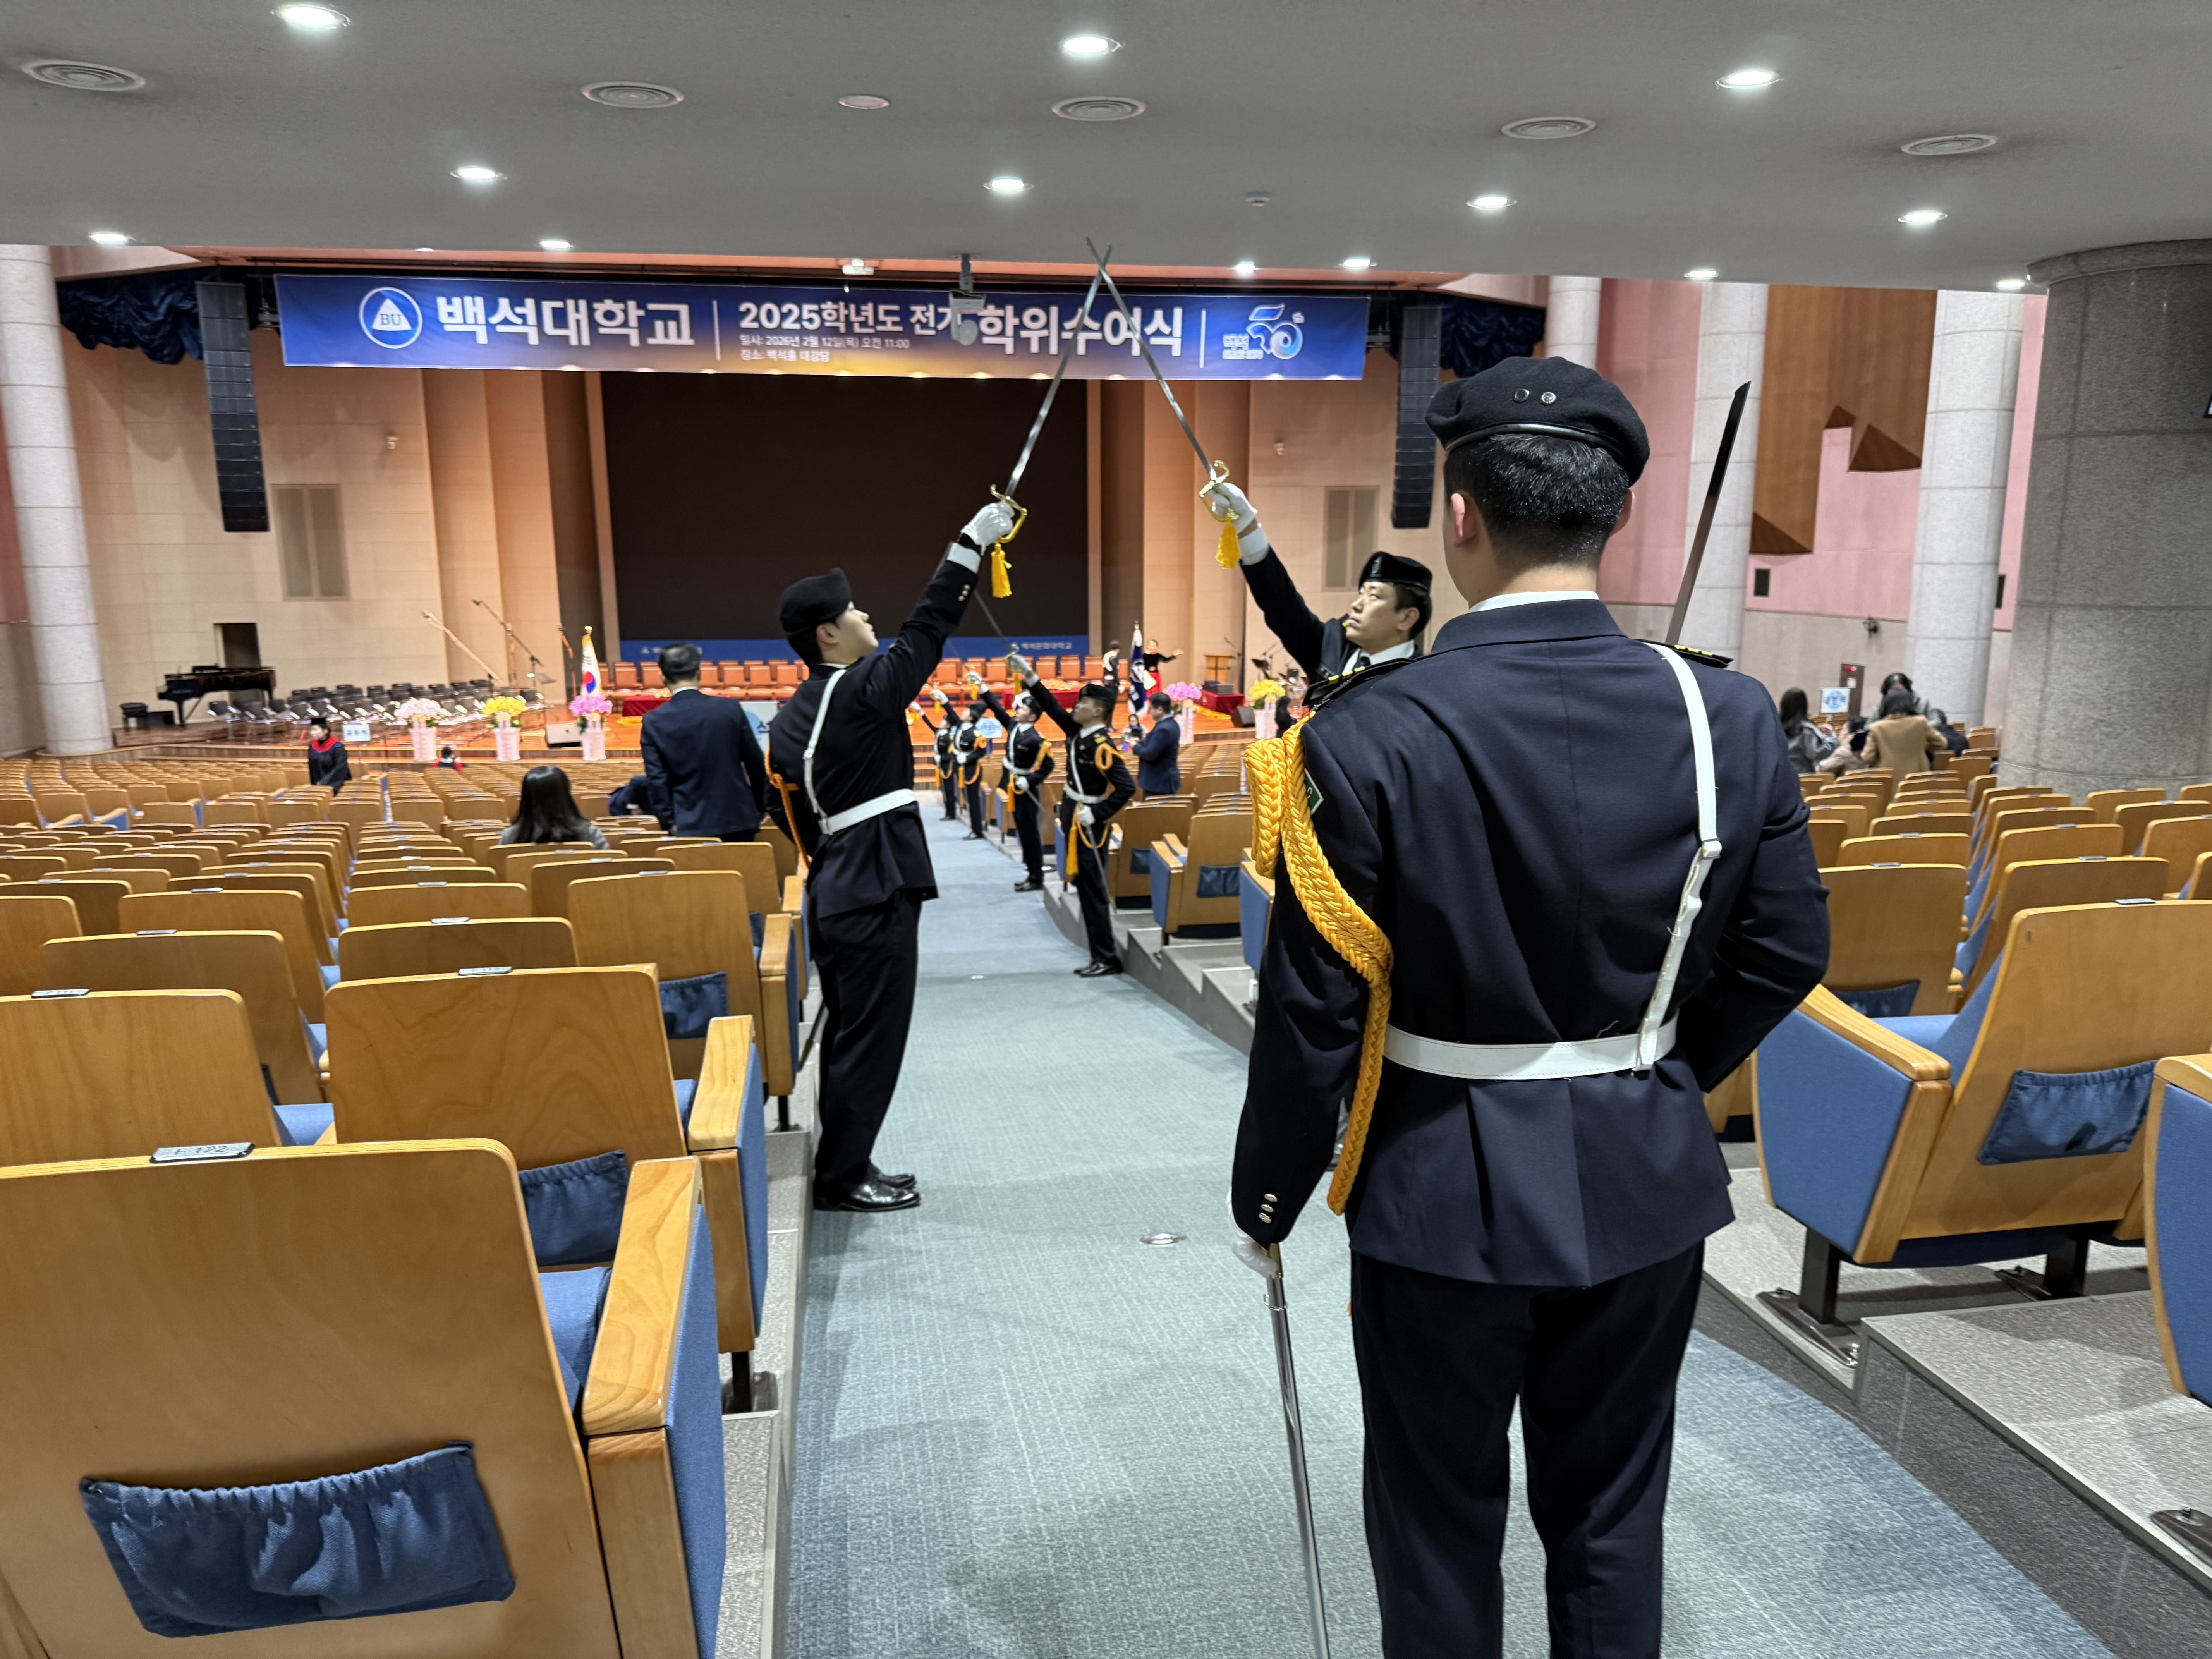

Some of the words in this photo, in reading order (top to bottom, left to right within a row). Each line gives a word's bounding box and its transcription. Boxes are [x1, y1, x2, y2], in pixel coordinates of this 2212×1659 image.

[379, 314, 401, 326] BU
[436, 295, 695, 347] 백석대학교
[739, 301, 903, 334] 2025학년도
[977, 304, 1182, 357] 학위수여식
[884, 339, 910, 349] 11:00
